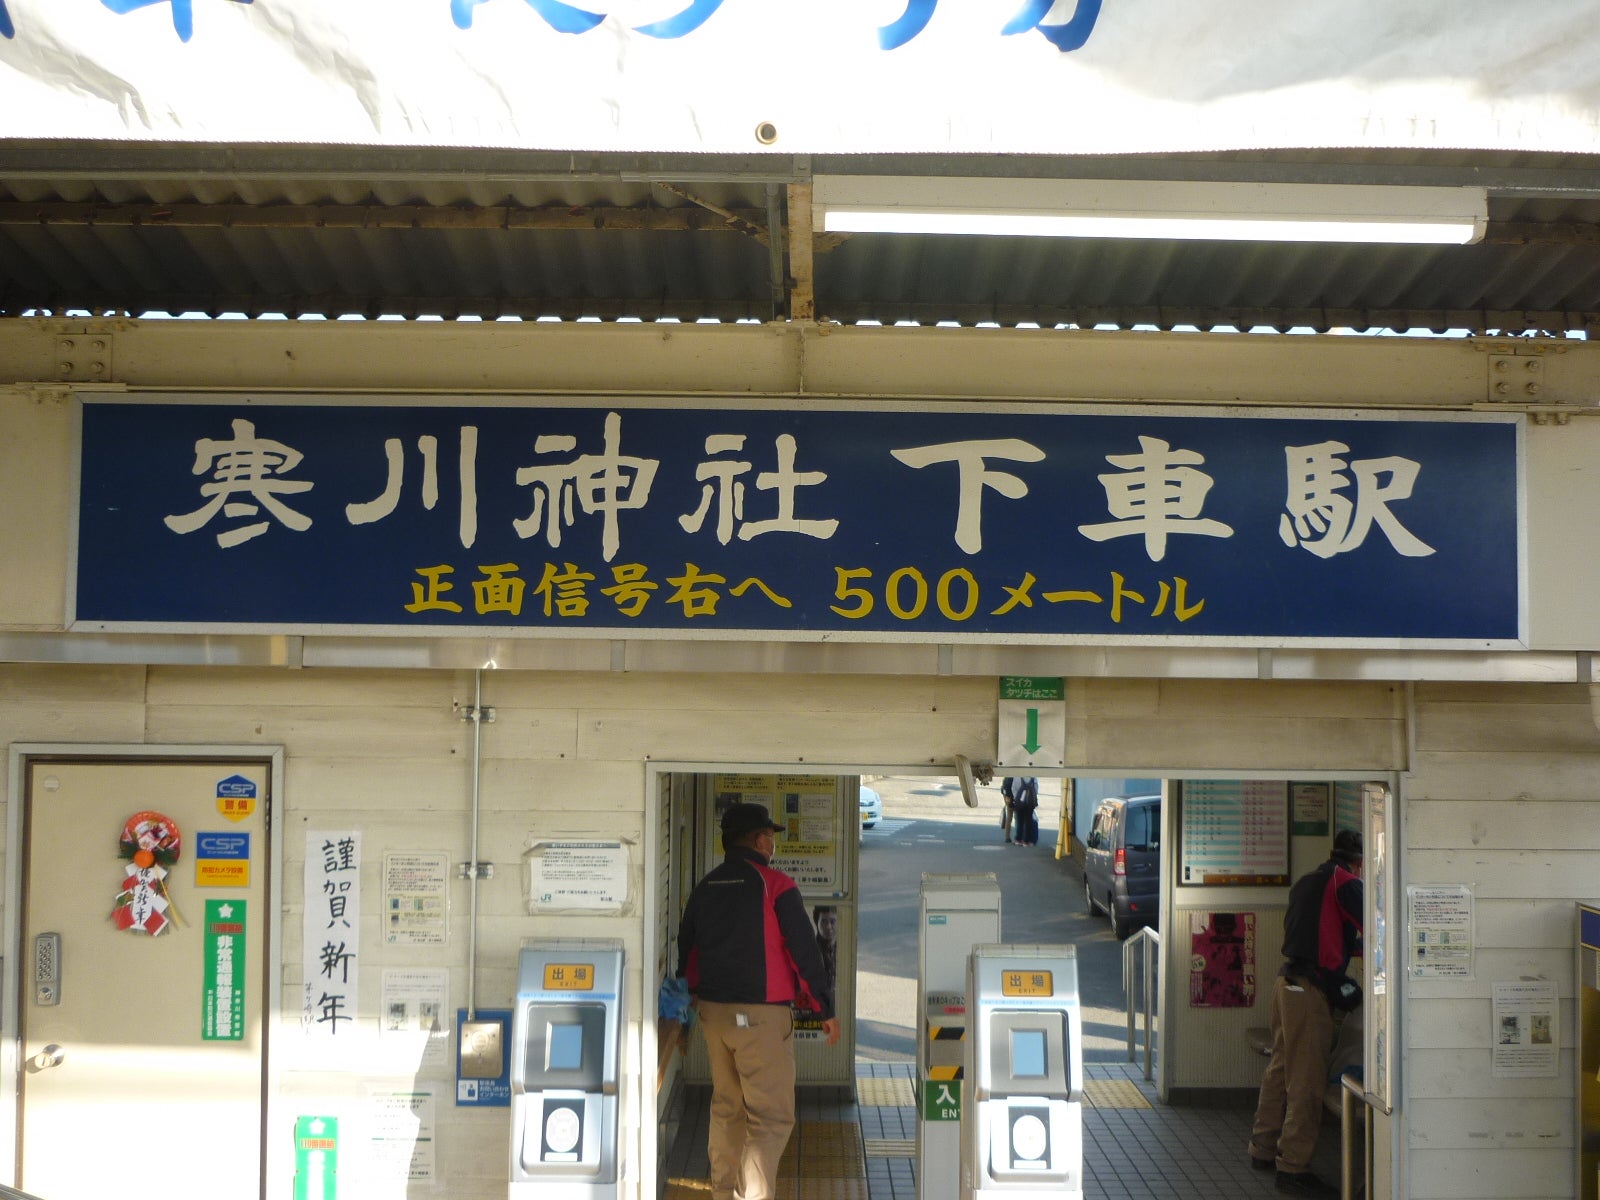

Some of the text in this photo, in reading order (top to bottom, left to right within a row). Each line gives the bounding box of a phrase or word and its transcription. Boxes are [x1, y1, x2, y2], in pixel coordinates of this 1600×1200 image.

[404, 562, 1205, 622] 正面信号右へ 500メートル
[1006, 678, 1032, 687] スイカ
[219, 783, 254, 794] CSP
[201, 838, 245, 850] CSP
[541, 893, 552, 903] JR
[317, 837, 357, 1035] 謹賀新年
[552, 967, 587, 980] 出場
[1010, 974, 1044, 987] 出場
[936, 1084, 956, 1105] 入
